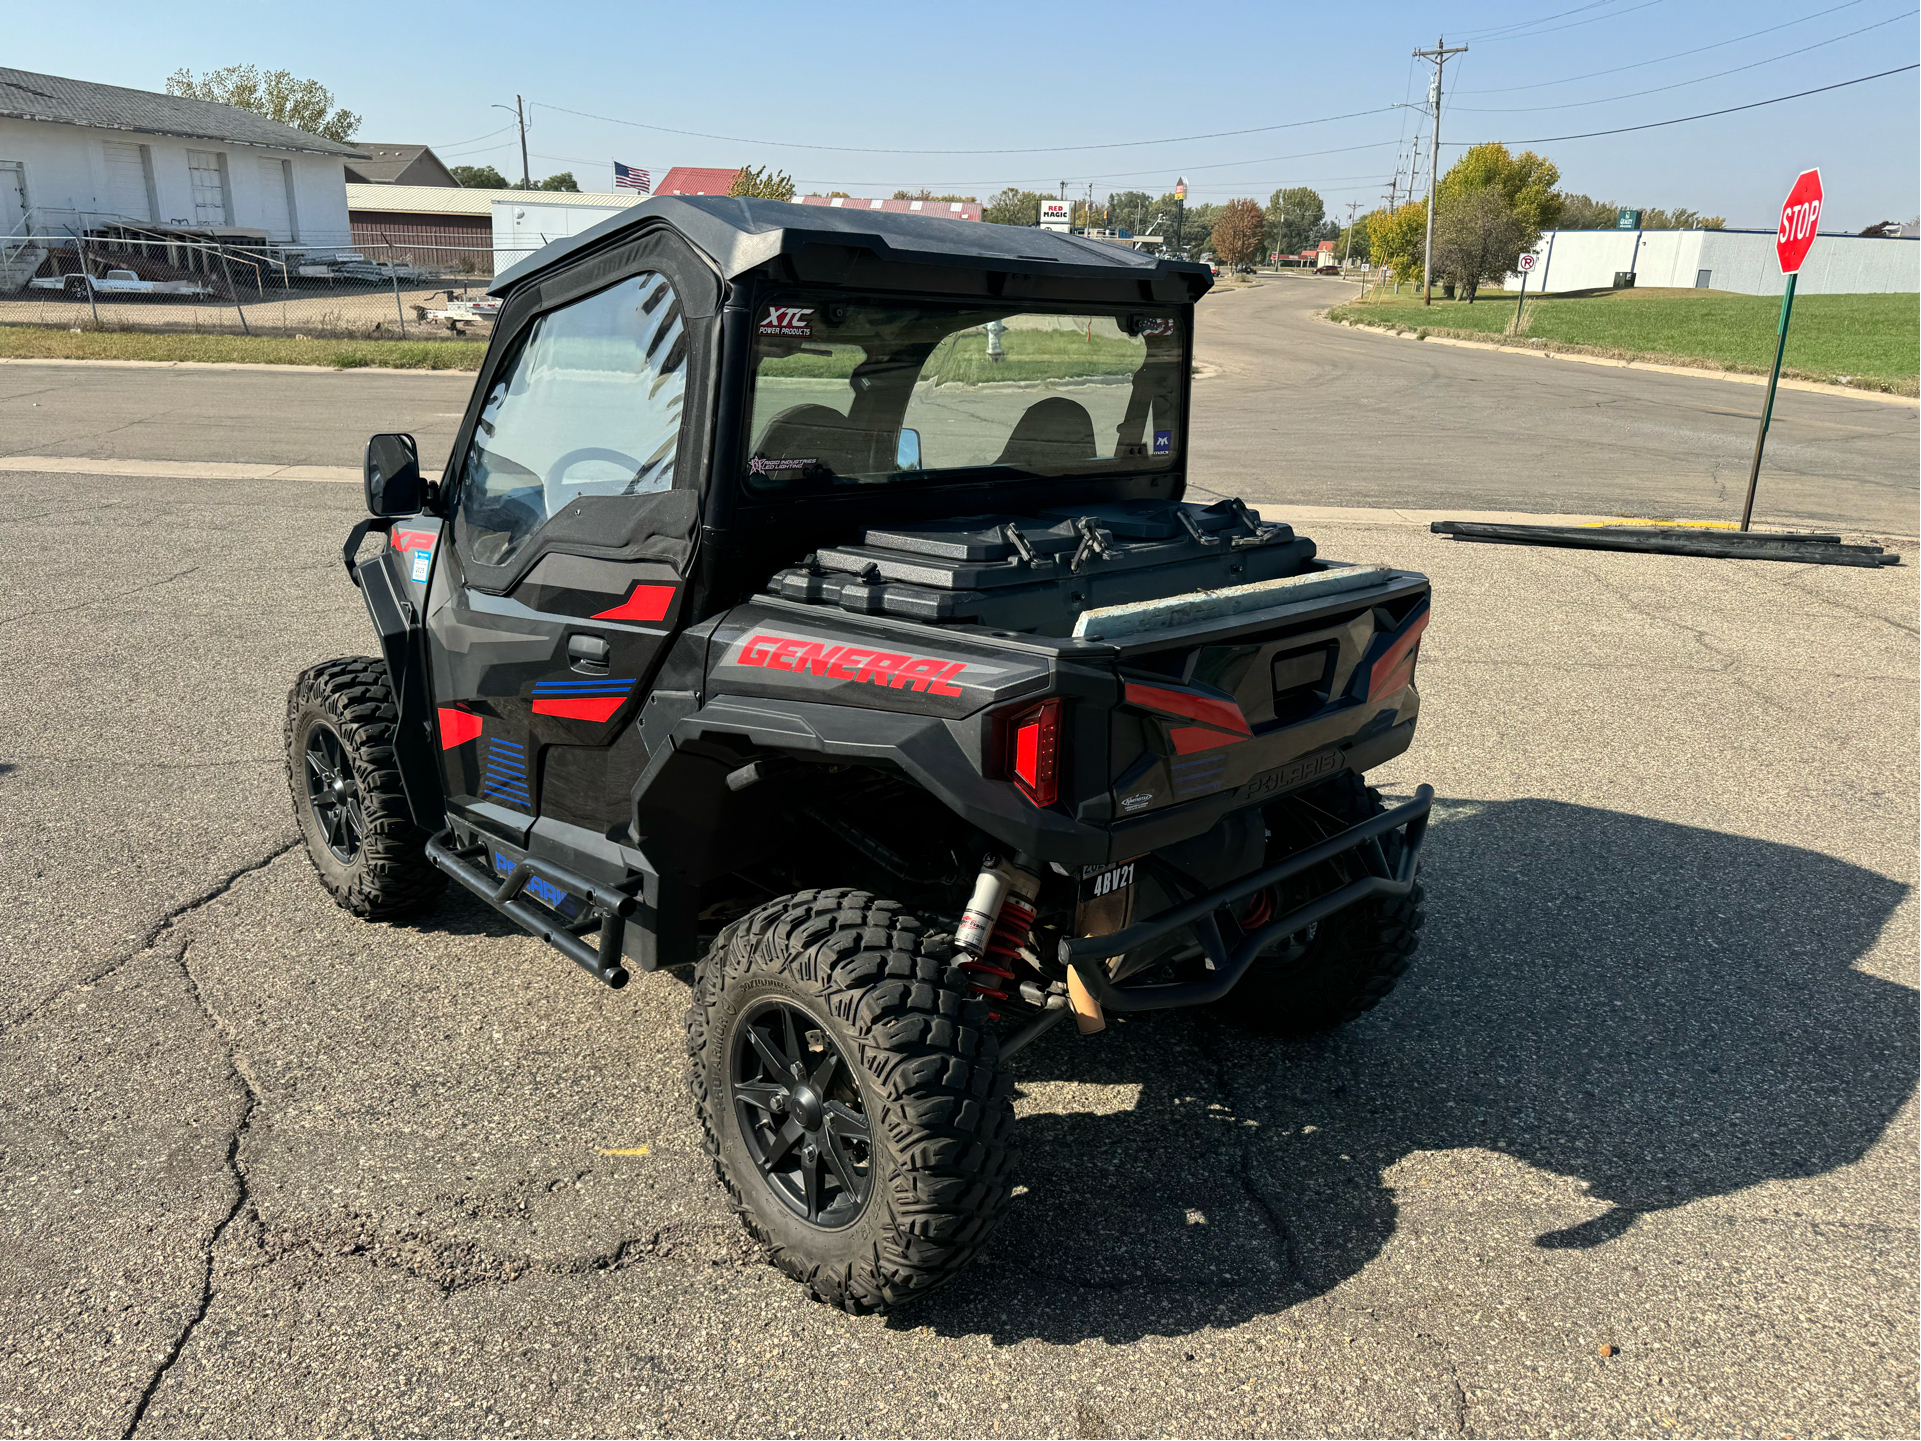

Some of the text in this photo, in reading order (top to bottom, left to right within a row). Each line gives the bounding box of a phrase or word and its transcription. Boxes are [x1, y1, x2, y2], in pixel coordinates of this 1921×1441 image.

[1780, 200, 1820, 243] STOP
[759, 326, 811, 336] POWER PRODUCTS
[760, 306, 815, 327] XTC
[391, 528, 438, 553] XP
[737, 634, 968, 698] GENERAL
[1245, 751, 1336, 800] POLARIS
[1093, 863, 1135, 897] 4BV21
[710, 1014, 729, 1073] ARMOR
